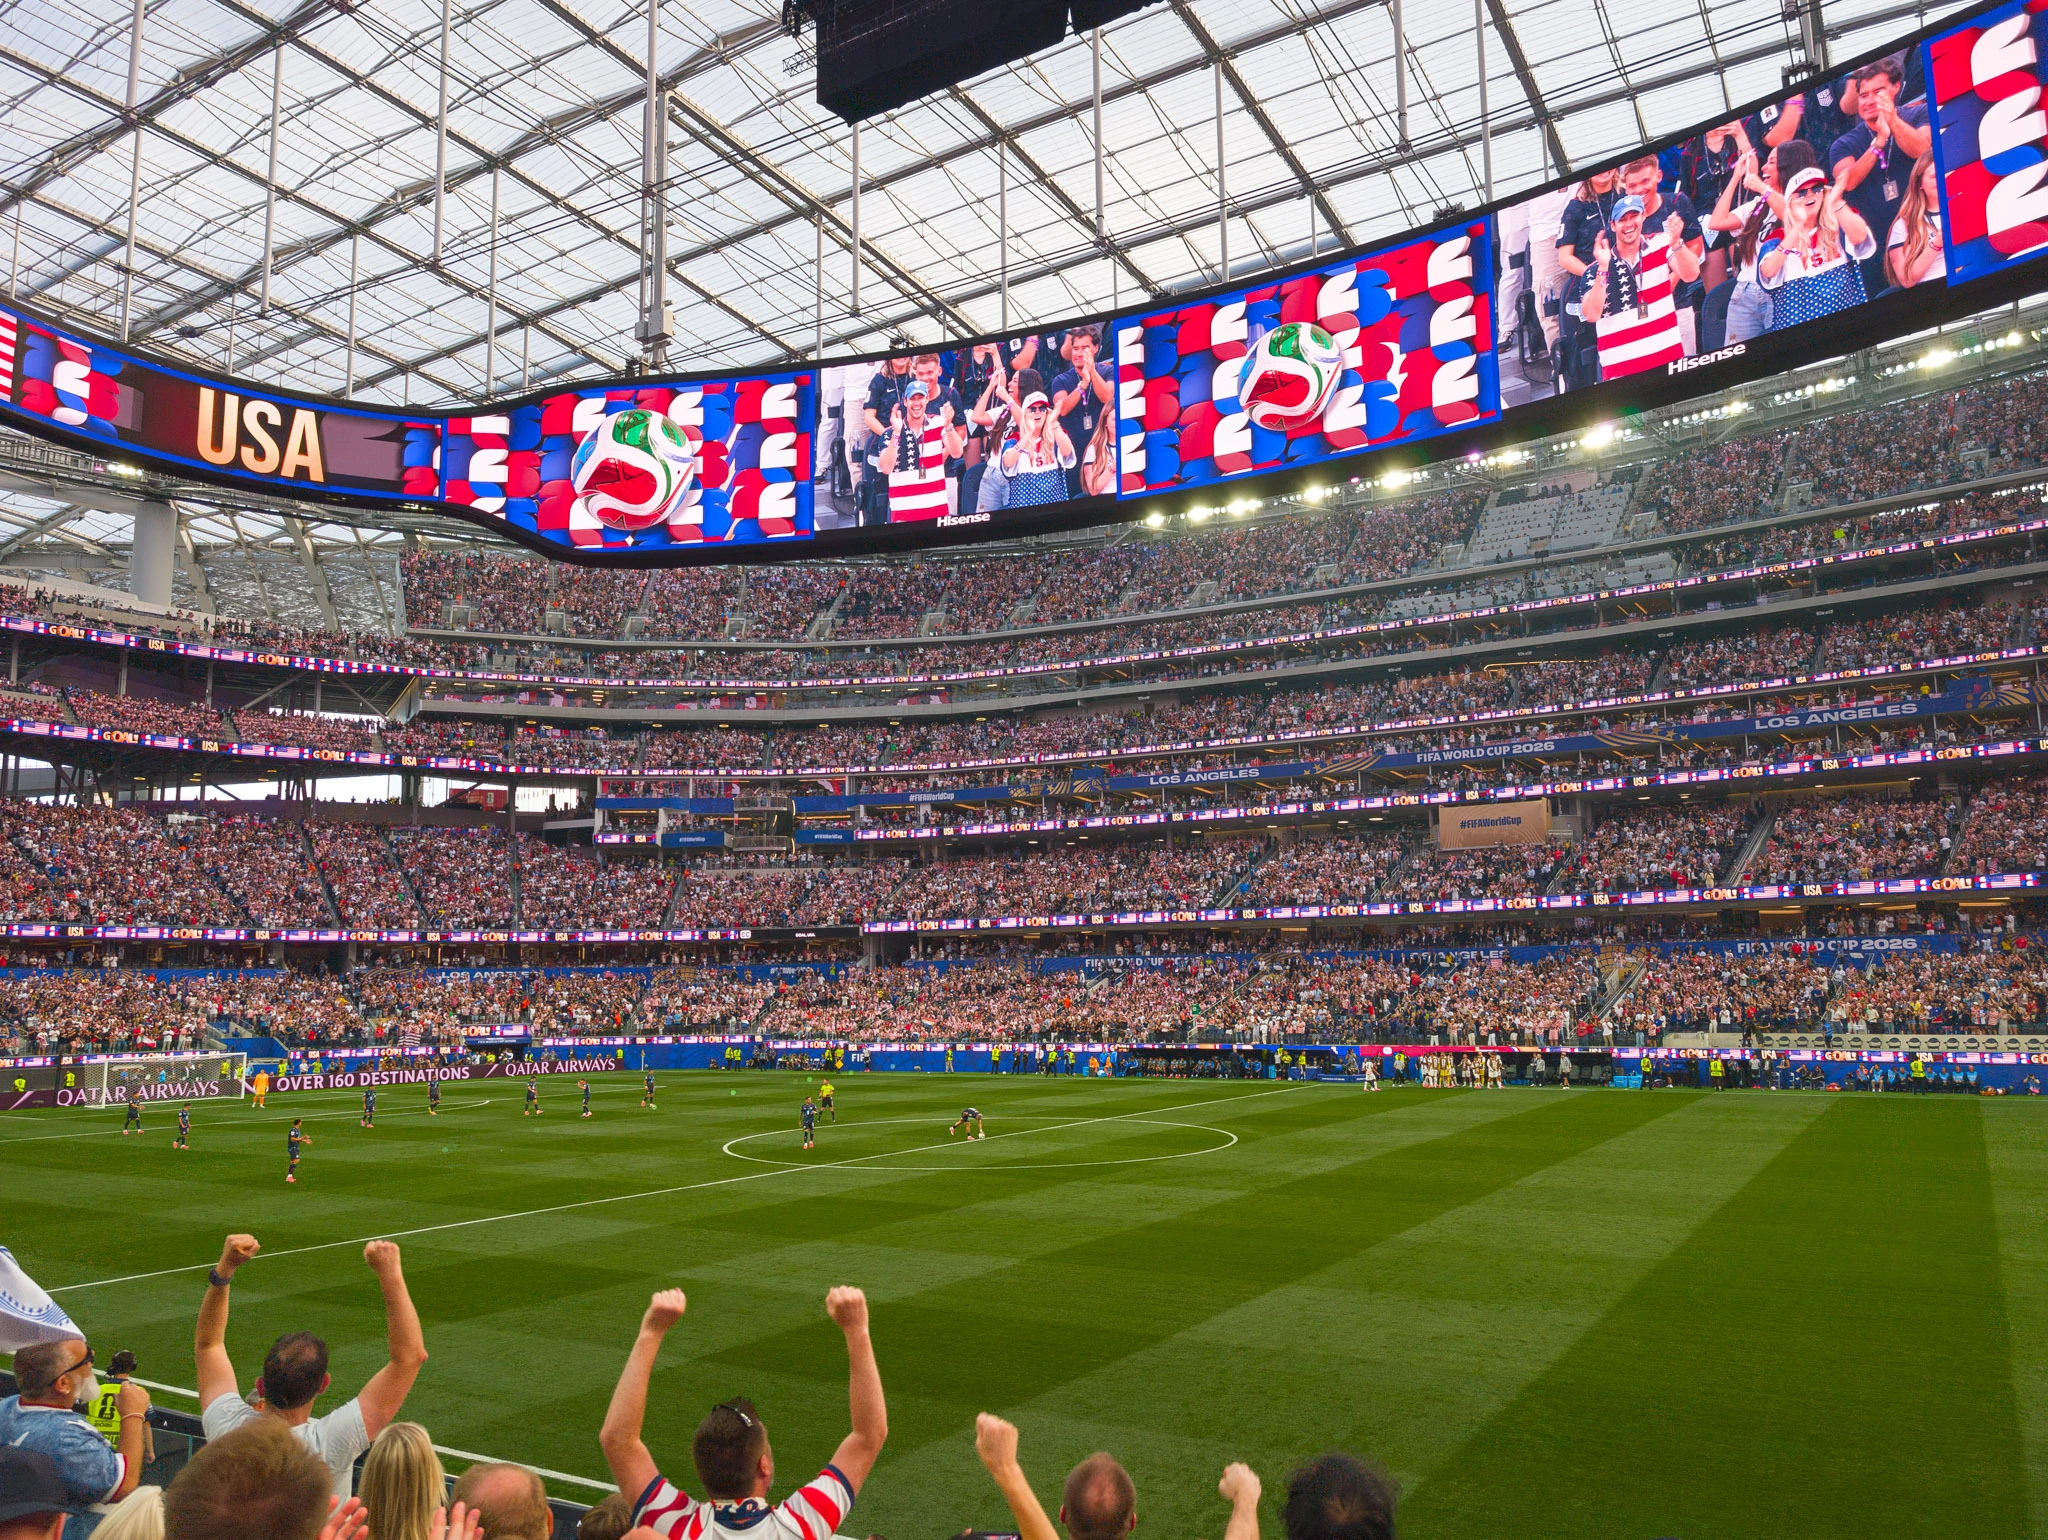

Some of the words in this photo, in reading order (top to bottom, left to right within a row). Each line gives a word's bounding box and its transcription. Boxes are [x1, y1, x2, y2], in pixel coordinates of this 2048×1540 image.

[1667, 343, 1746, 376] Hisense
[196, 387, 325, 483] USA
[937, 512, 990, 528] Hisense
[1994, 525, 2017, 535] GOAL!
[1865, 548, 1885, 557] GOAL!
[1769, 564, 1788, 573] GOAL!
[49, 625, 86, 639] GOAL!
[148, 639, 165, 651] USA
[257, 653, 290, 666] GOAL!
[1975, 652, 1999, 662] GOAL!
[1839, 669, 1860, 678] GOAL!
[1739, 682, 1759, 690] GOAL!
[1755, 716, 1800, 730] LOS
[1805, 703, 1918, 725] ANGELES
[103, 730, 138, 743] GOAL!
[202, 741, 219, 752] USA
[1416, 753, 1441, 763] FIFA
[1442, 749, 1484, 761] WORLD
[1486, 746, 1510, 756] CUP
[1512, 740, 1555, 754] 2026
[313, 749, 345, 762] GOAL!
[1936, 747, 1972, 759] GOAL!
[402, 756, 417, 766] USA
[1822, 759, 1839, 770] USA
[1150, 774, 1181, 785] LOS
[1184, 768, 1260, 783] ANGELES
[1732, 766, 1764, 778] GOAL!
[1633, 775, 1648, 785] USA
[1554, 781, 1582, 793] GOAL!
[909, 792, 955, 802] #FIFAWorldCup
[1466, 790, 1479, 800] USA
[1394, 795, 1419, 806] GOAL!
[1247, 806, 1270, 816] GOAL!
[1313, 802, 1325, 812] USA
[1112, 816, 1133, 825] GOAL!
[1172, 812, 1184, 821] USA
[1010, 822, 1031, 832] GOAL!
[1068, 820, 1079, 828] USA
[1460, 816, 1522, 829] #FIFAWorldCup
[886, 830, 907, 839] GOAL!
[943, 827, 954, 836] USA
[634, 835, 646, 843] USA
[1931, 877, 1972, 890] GOAL!
[1703, 888, 1737, 901] GOAL!
[1803, 885, 1822, 896] USA
[1506, 898, 1537, 910] GOAL!
[1593, 894, 1609, 904] USA
[1330, 905, 1358, 916] GOAL!
[1409, 902, 1423, 913] USA
[1171, 911, 1196, 921] GOAL!
[1243, 909, 1256, 919] USA
[979, 919, 991, 928] USA
[1026, 917, 1049, 927] GOAL!
[1092, 915, 1104, 924] USA
[916, 921, 939, 931] GOAL!
[68, 926, 84, 937] USA
[172, 928, 202, 939] GOAL!
[255, 930, 270, 940] USA
[350, 931, 378, 941] GOAL!
[427, 932, 441, 941] USA
[482, 931, 509, 941] GOAL!
[555, 932, 568, 941] USA
[638, 931, 663, 941] GOAL!
[708, 931, 720, 940] USA
[1861, 937, 1918, 950] 2026
[441, 971, 469, 979] LOS
[461, 1025, 491, 1037] GOAL!
[440, 1046, 451, 1054] USA
[848, 1043, 858, 1051] USA
[308, 1050, 320, 1059] USA
[851, 1053, 865, 1062] FIF
[1679, 1049, 1708, 1059] GOAL!
[1761, 1050, 1777, 1060] USA
[1825, 1050, 1857, 1061] GOAL!
[505, 1061, 550, 1076] QATAR
[554, 1058, 616, 1073] AIRWAYS
[276, 1075, 324, 1092] OVER
[329, 1073, 355, 1088] 160
[360, 1066, 470, 1086] DESTINATIONS
[57, 1086, 127, 1107] QATAR
[138, 1080, 220, 1102] AIRWAYS
